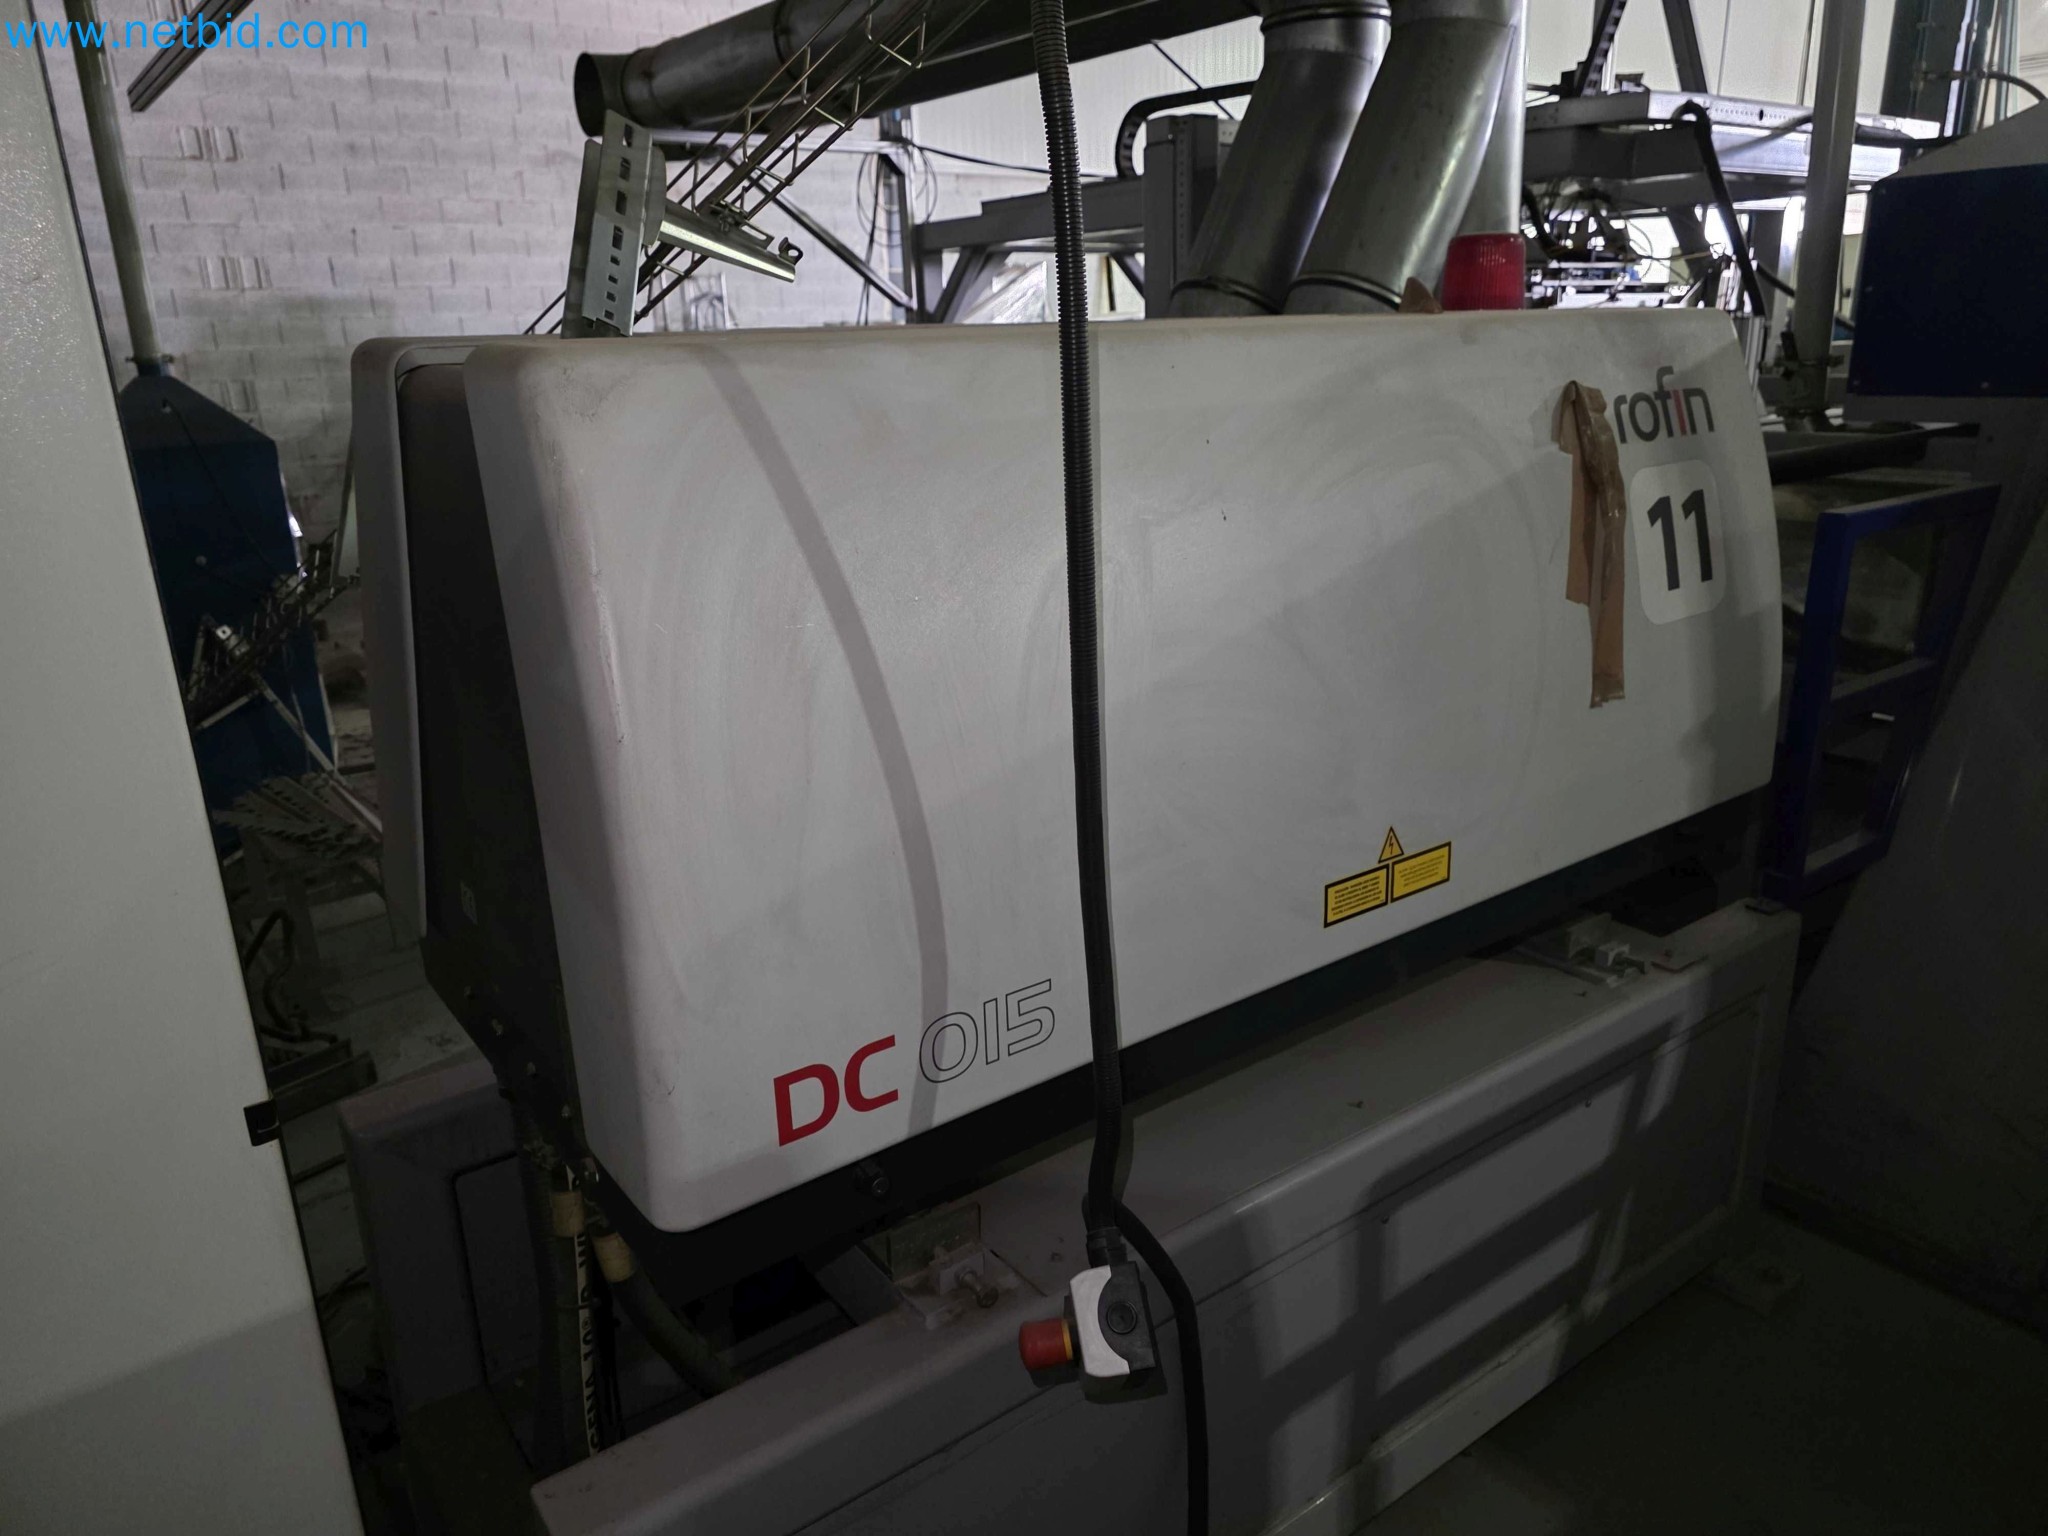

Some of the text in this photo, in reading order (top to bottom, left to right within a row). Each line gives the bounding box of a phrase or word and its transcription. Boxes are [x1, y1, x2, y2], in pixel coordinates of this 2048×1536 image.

[1613, 365, 1715, 444] rofin
[1647, 489, 1713, 591] 11
[773, 978, 1056, 1147] DC 015
